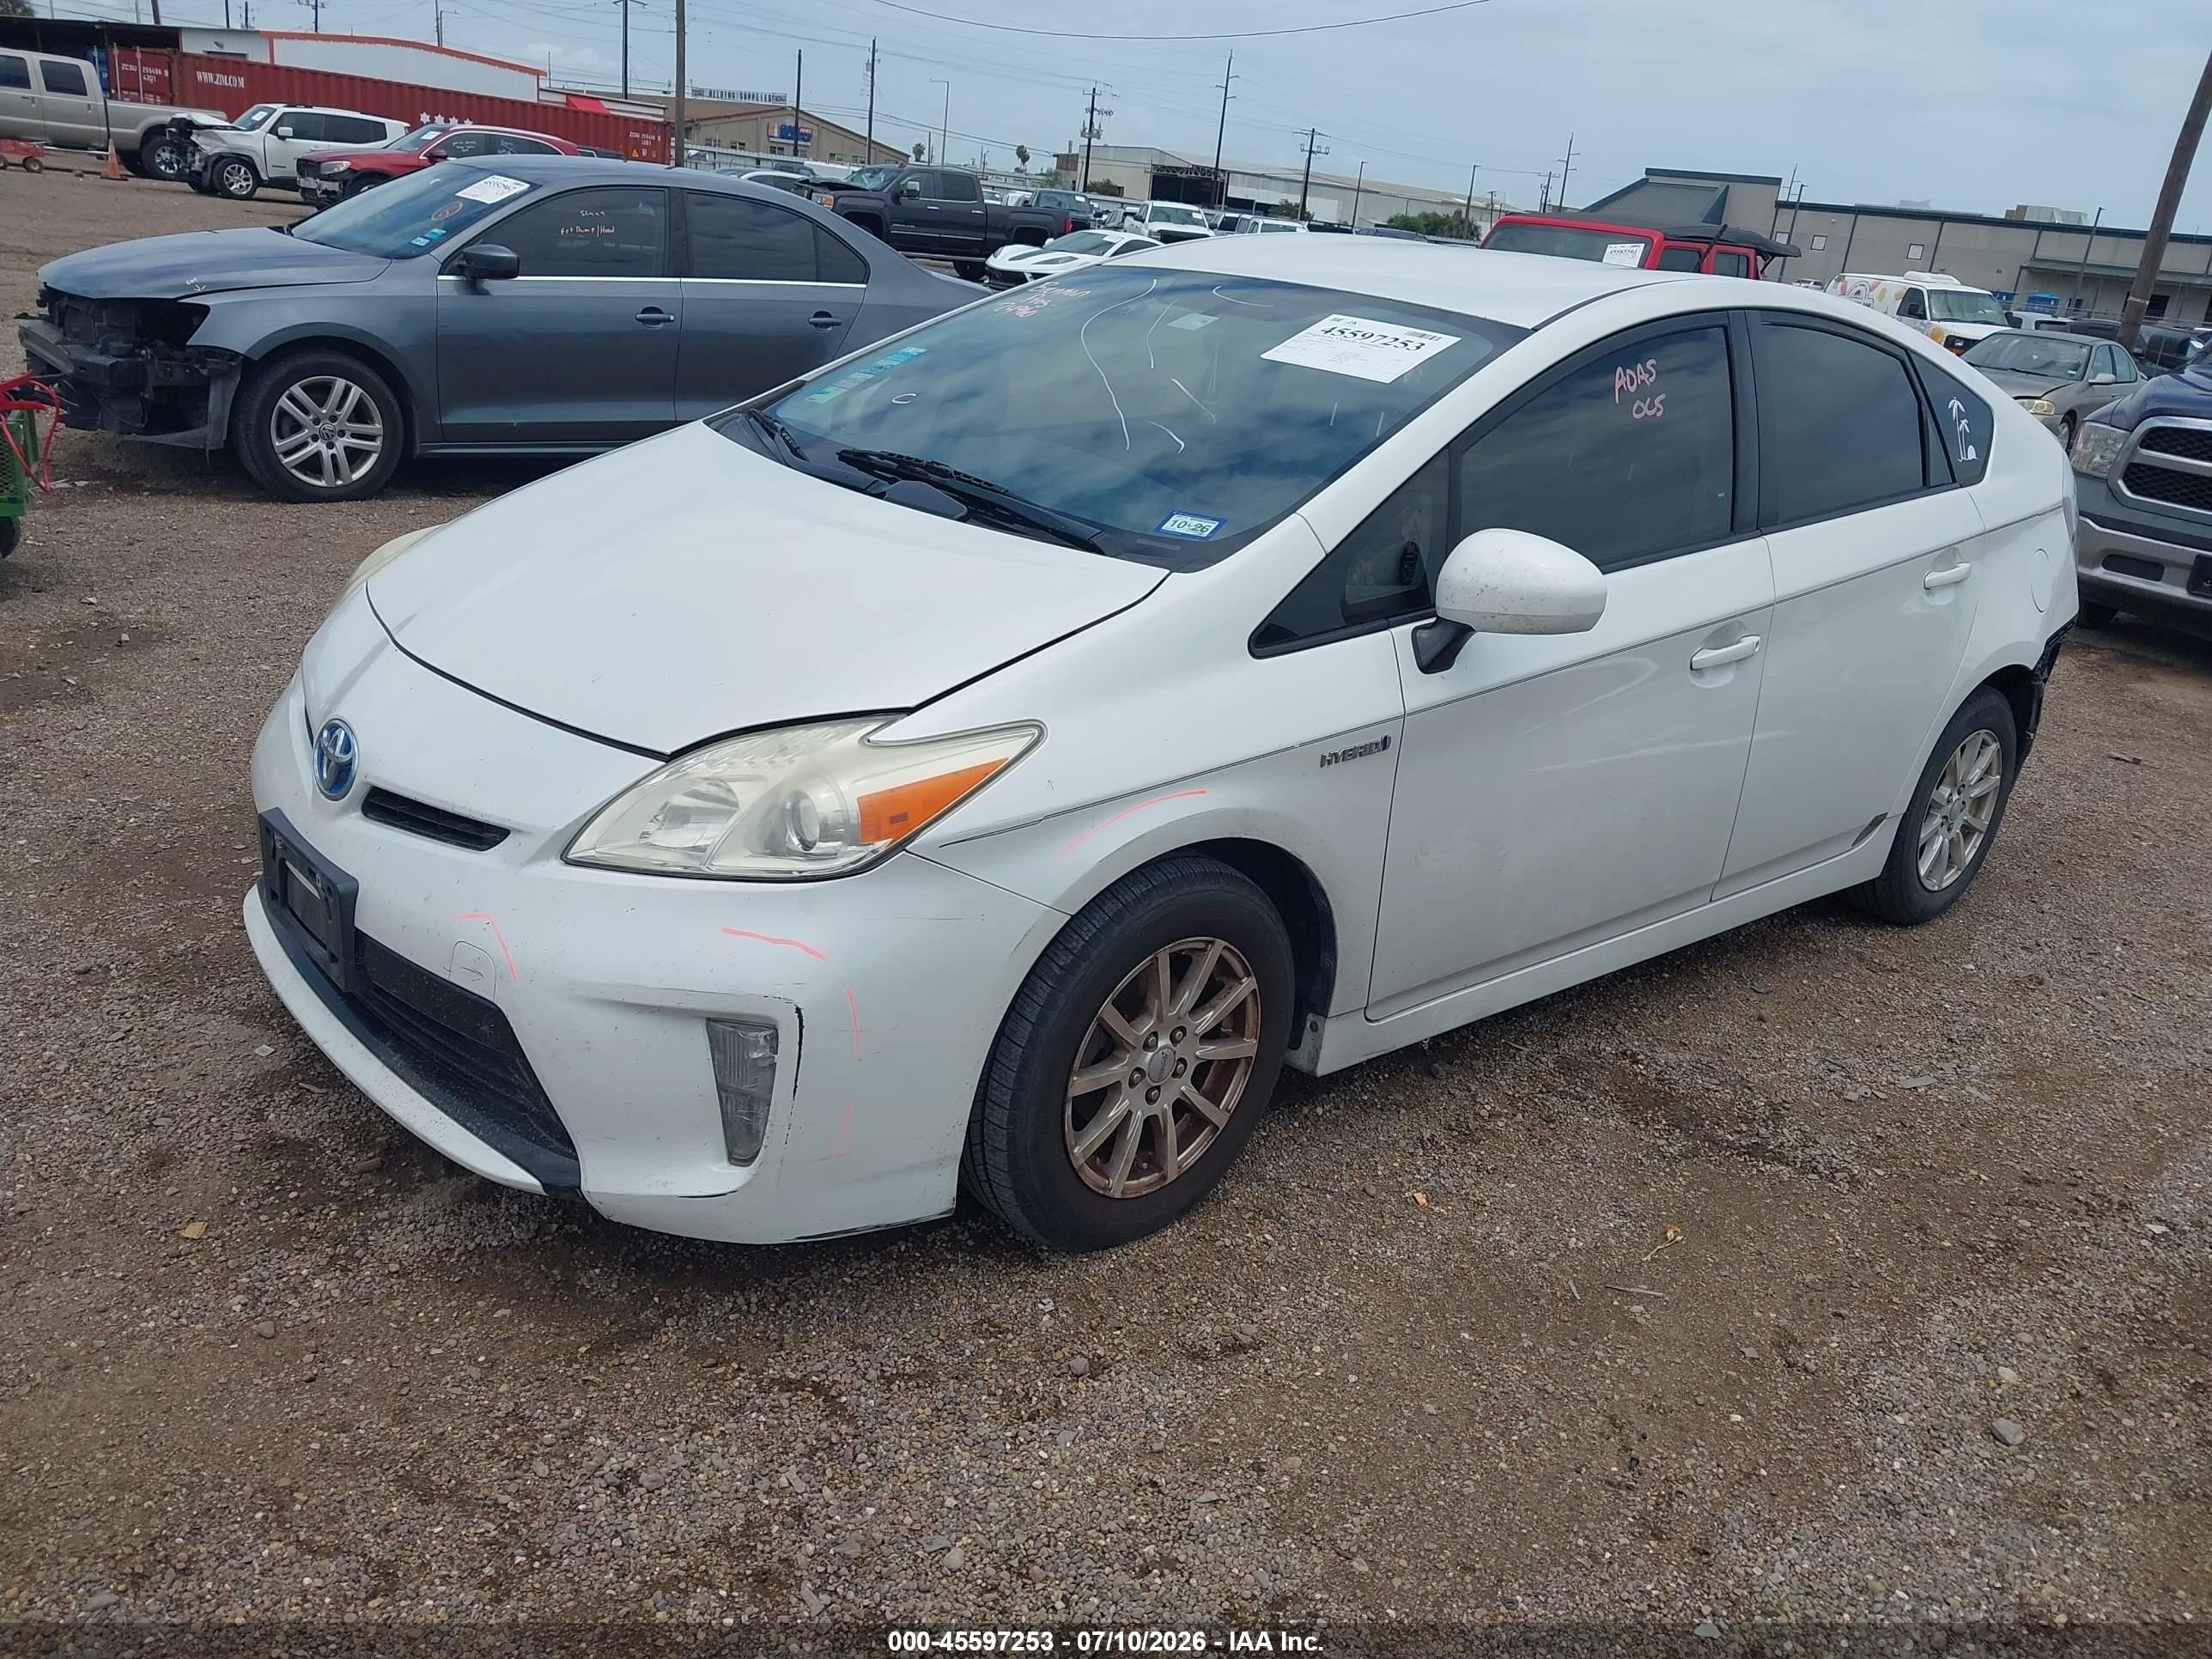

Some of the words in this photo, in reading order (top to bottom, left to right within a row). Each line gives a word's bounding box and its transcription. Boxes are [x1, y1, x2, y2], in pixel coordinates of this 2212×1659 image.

[196, 70, 245, 88] WWW.ZIM.COM
[1320, 325, 1426, 352] 45597253
[1614, 358, 1657, 404] ADAS
[1319, 740, 1382, 769] HYBRID
